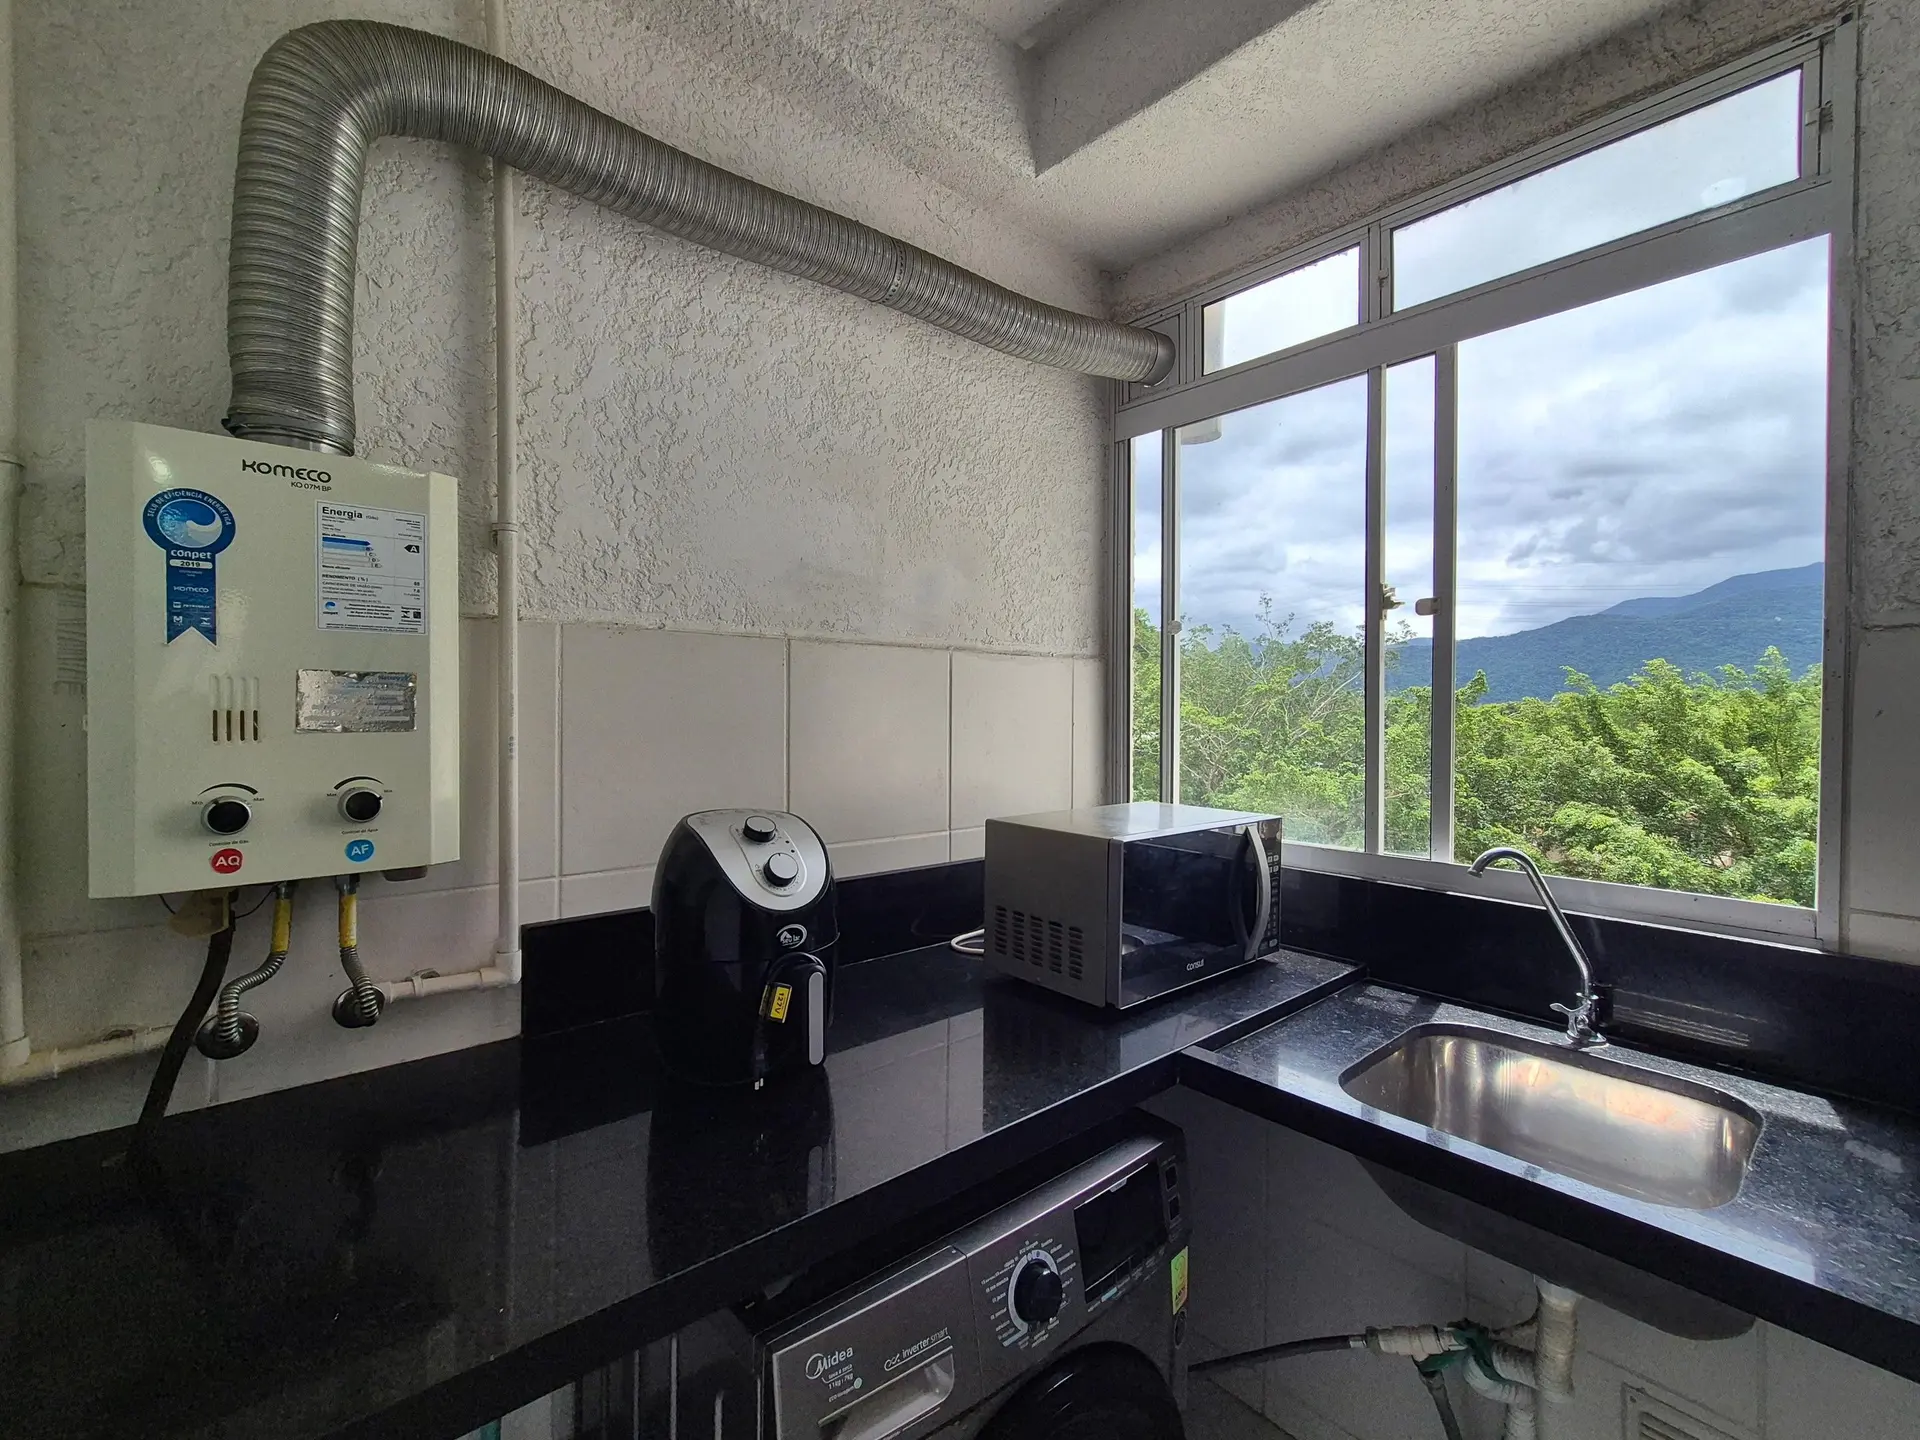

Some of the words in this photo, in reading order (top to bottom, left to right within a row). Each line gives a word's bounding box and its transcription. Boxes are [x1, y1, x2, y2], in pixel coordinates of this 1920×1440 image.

[322, 506, 363, 519] Energia
[170, 549, 212, 559] conpet
[180, 560, 201, 568] 2019
[351, 844, 369, 856] AF
[215, 855, 240, 867] AQ
[774, 992, 784, 1014] 127V
[902, 1337, 930, 1359] inverter
[806, 1346, 853, 1380] Midea
